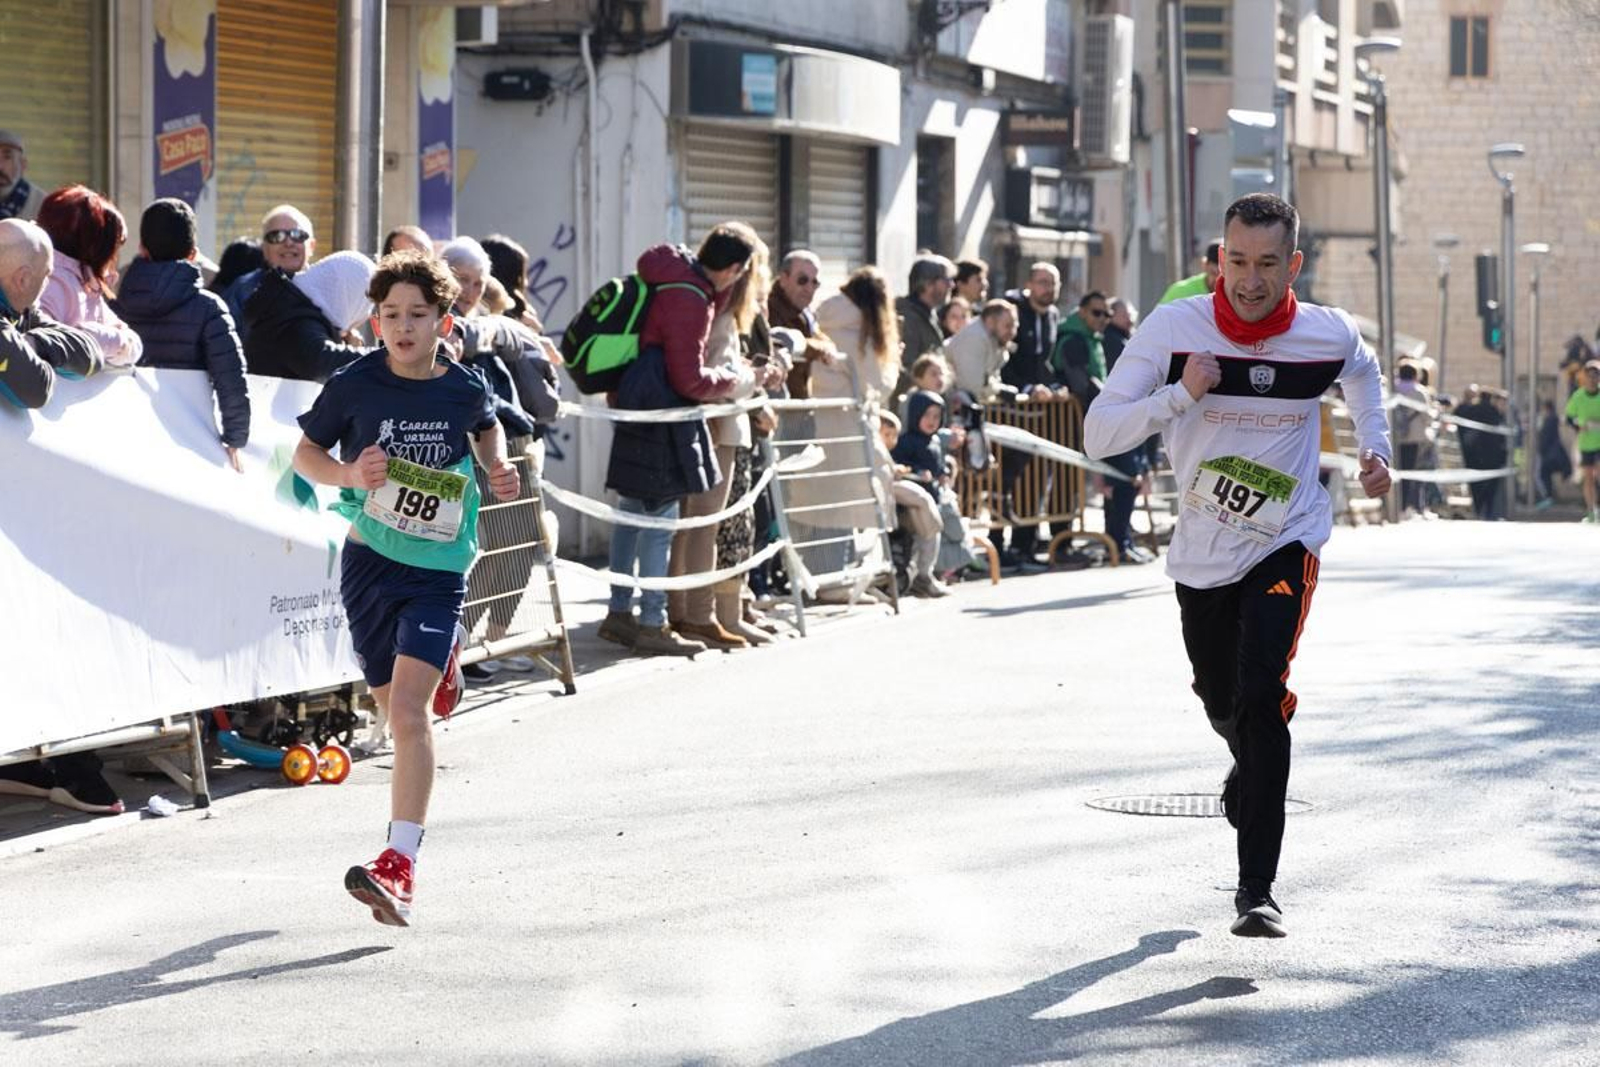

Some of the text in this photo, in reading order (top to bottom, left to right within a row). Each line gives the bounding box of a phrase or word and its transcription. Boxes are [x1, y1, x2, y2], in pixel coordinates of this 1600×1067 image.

[393, 486, 440, 522] 198
[1212, 474, 1268, 518] 497
[269, 594, 319, 614] Patronato
